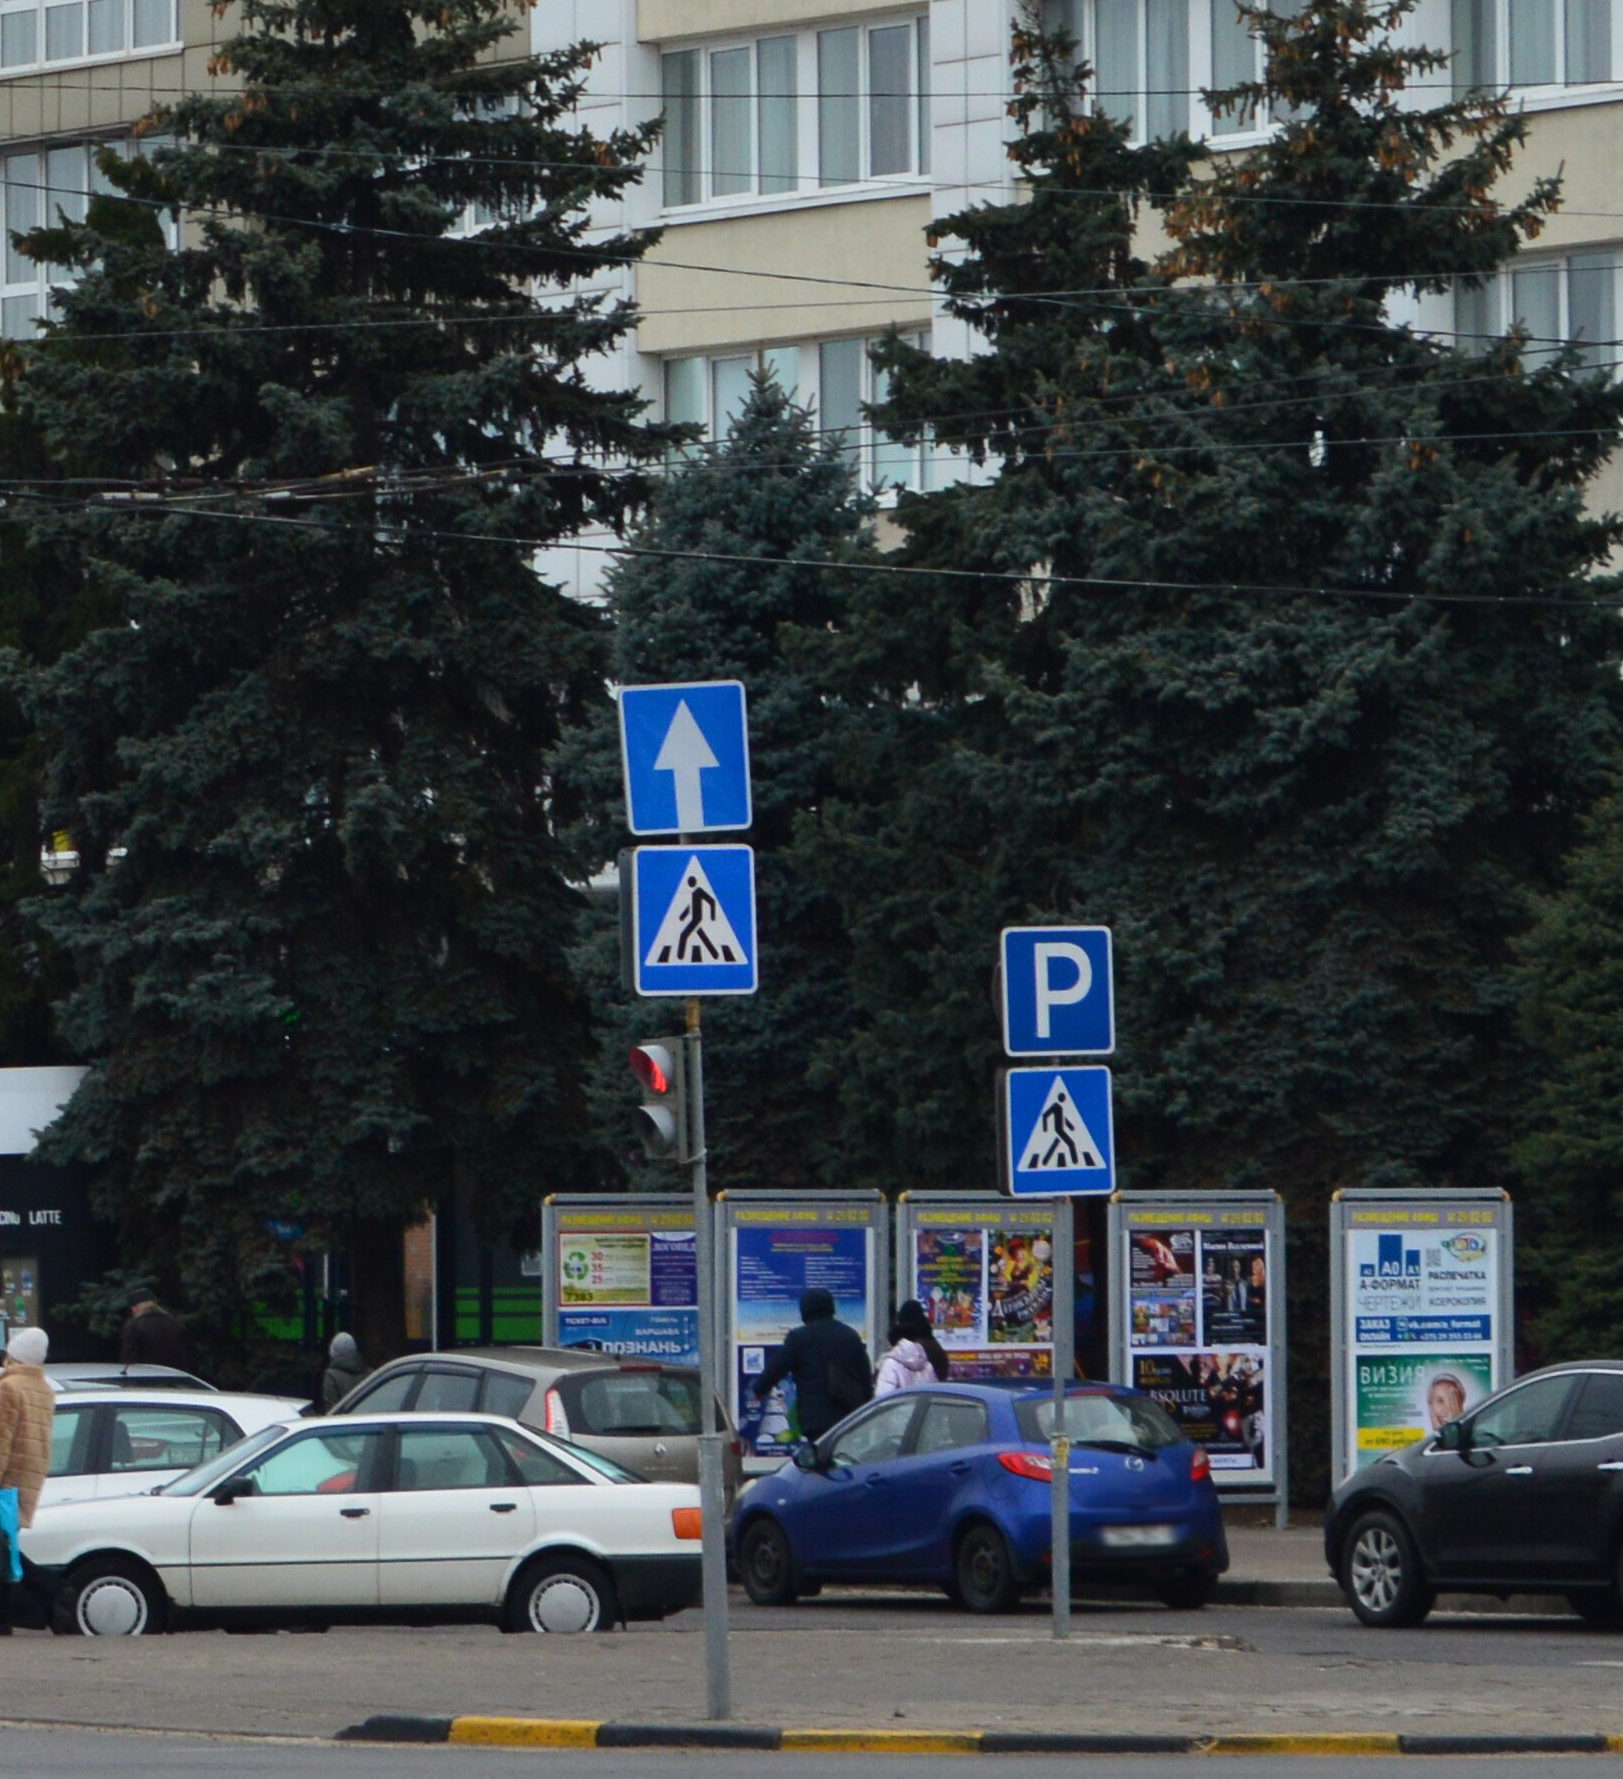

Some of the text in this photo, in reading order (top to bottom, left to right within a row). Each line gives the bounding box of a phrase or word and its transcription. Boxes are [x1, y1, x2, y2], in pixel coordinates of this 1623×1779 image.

[29, 1210, 62, 1225] LATTE
[591, 1252, 604, 1261] 30
[591, 1275, 604, 1284] 25
[1428, 1270, 1486, 1281] РАСПЕЧАТКА
[1360, 1278, 1421, 1290] А-ФОРМАТ
[1359, 1295, 1421, 1311] ЧЕРТЕЖИ
[1359, 1318, 1391, 1330] ЗАКАЗ
[601, 1341, 682, 1354] ПОЗНАНЬ
[1359, 1365, 1425, 1385] ВИЗИЯ
